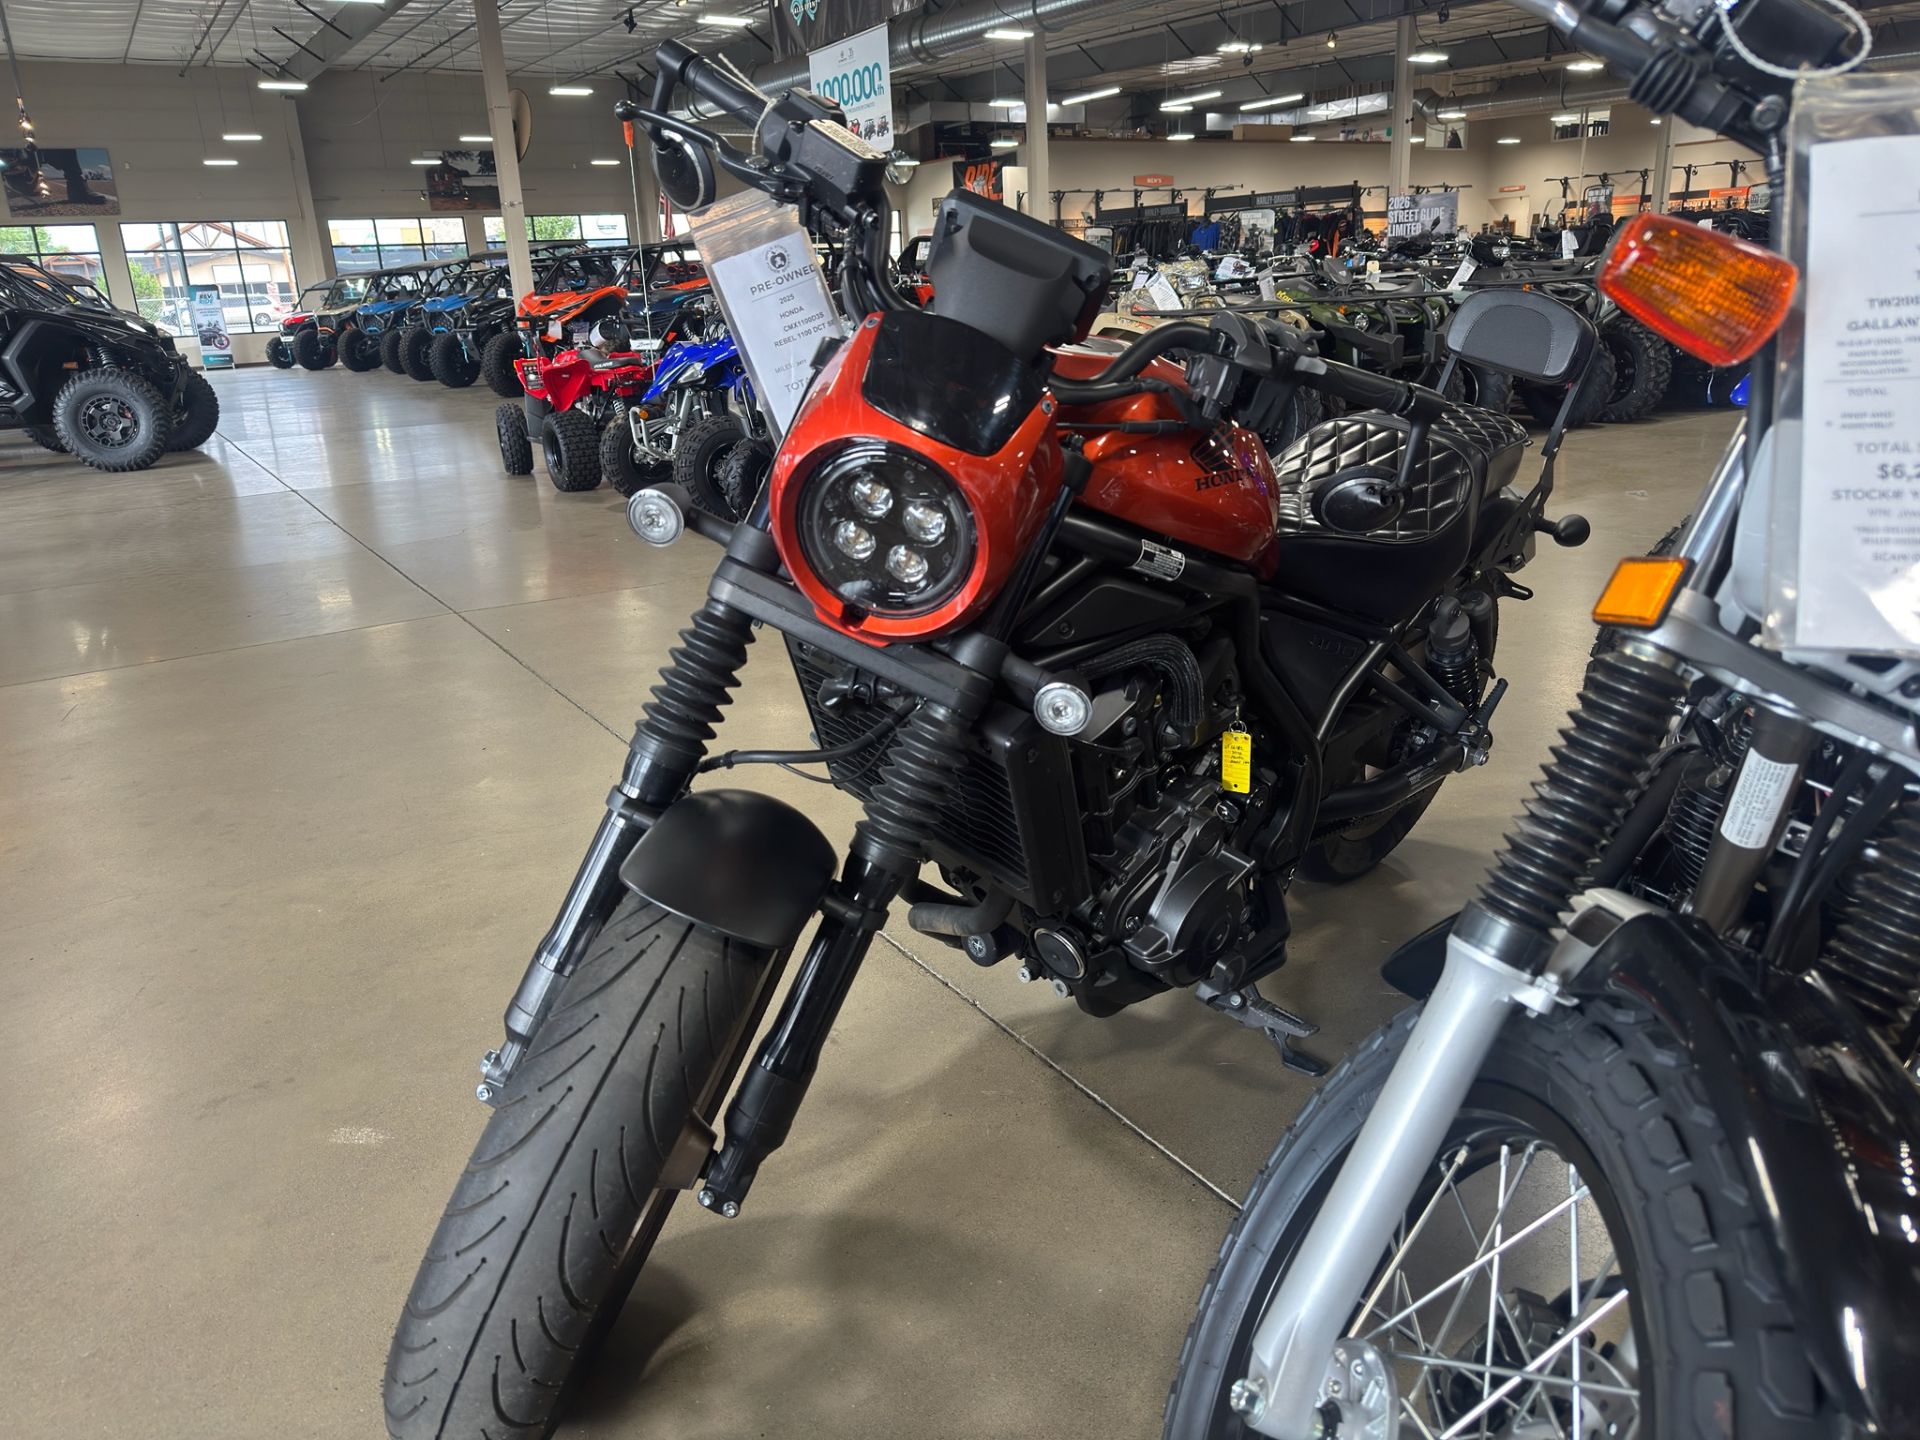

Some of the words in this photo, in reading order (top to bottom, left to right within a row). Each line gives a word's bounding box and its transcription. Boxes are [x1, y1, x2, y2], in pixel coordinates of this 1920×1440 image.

[1389, 196, 1410, 210] 2026
[1388, 209, 1419, 223] STREET
[1421, 206, 1445, 220] GLIDE
[1388, 222, 1421, 237] LIMITED
[750, 264, 816, 295] PRE-OWNED
[779, 293, 795, 304] 2025
[779, 306, 805, 319] HONDA
[1846, 317, 1920, 331] GALLAN
[774, 335, 797, 348] REBEL
[797, 328, 812, 339] 1100
[812, 322, 826, 333] DCT
[1855, 441, 1911, 454] TOTAL
